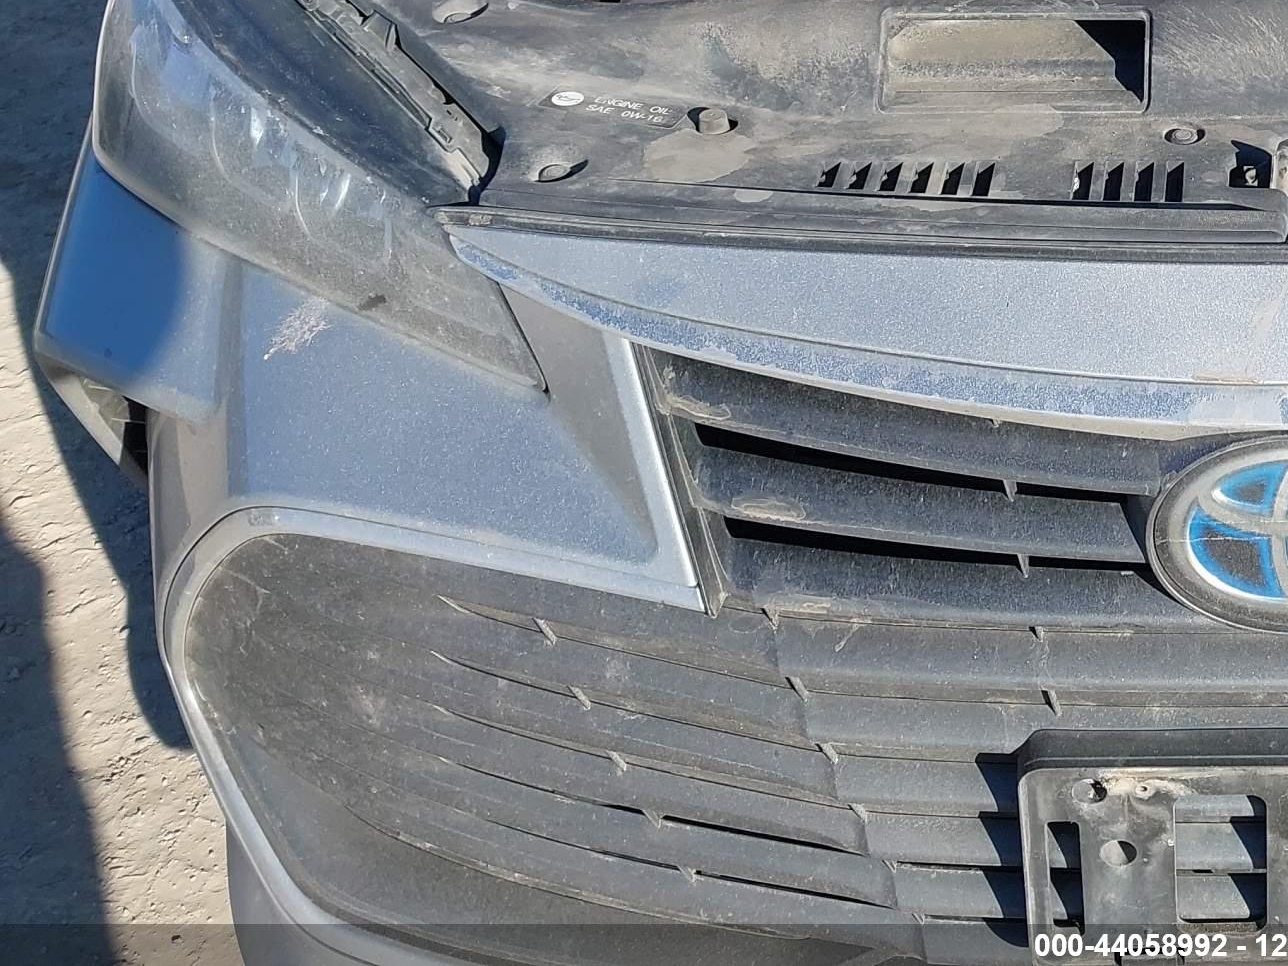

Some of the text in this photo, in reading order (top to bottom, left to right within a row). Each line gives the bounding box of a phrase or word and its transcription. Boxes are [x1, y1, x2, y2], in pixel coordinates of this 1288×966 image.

[585, 104, 664, 123] SAE 0W-16
[594, 96, 671, 115] ENGINE OIL
